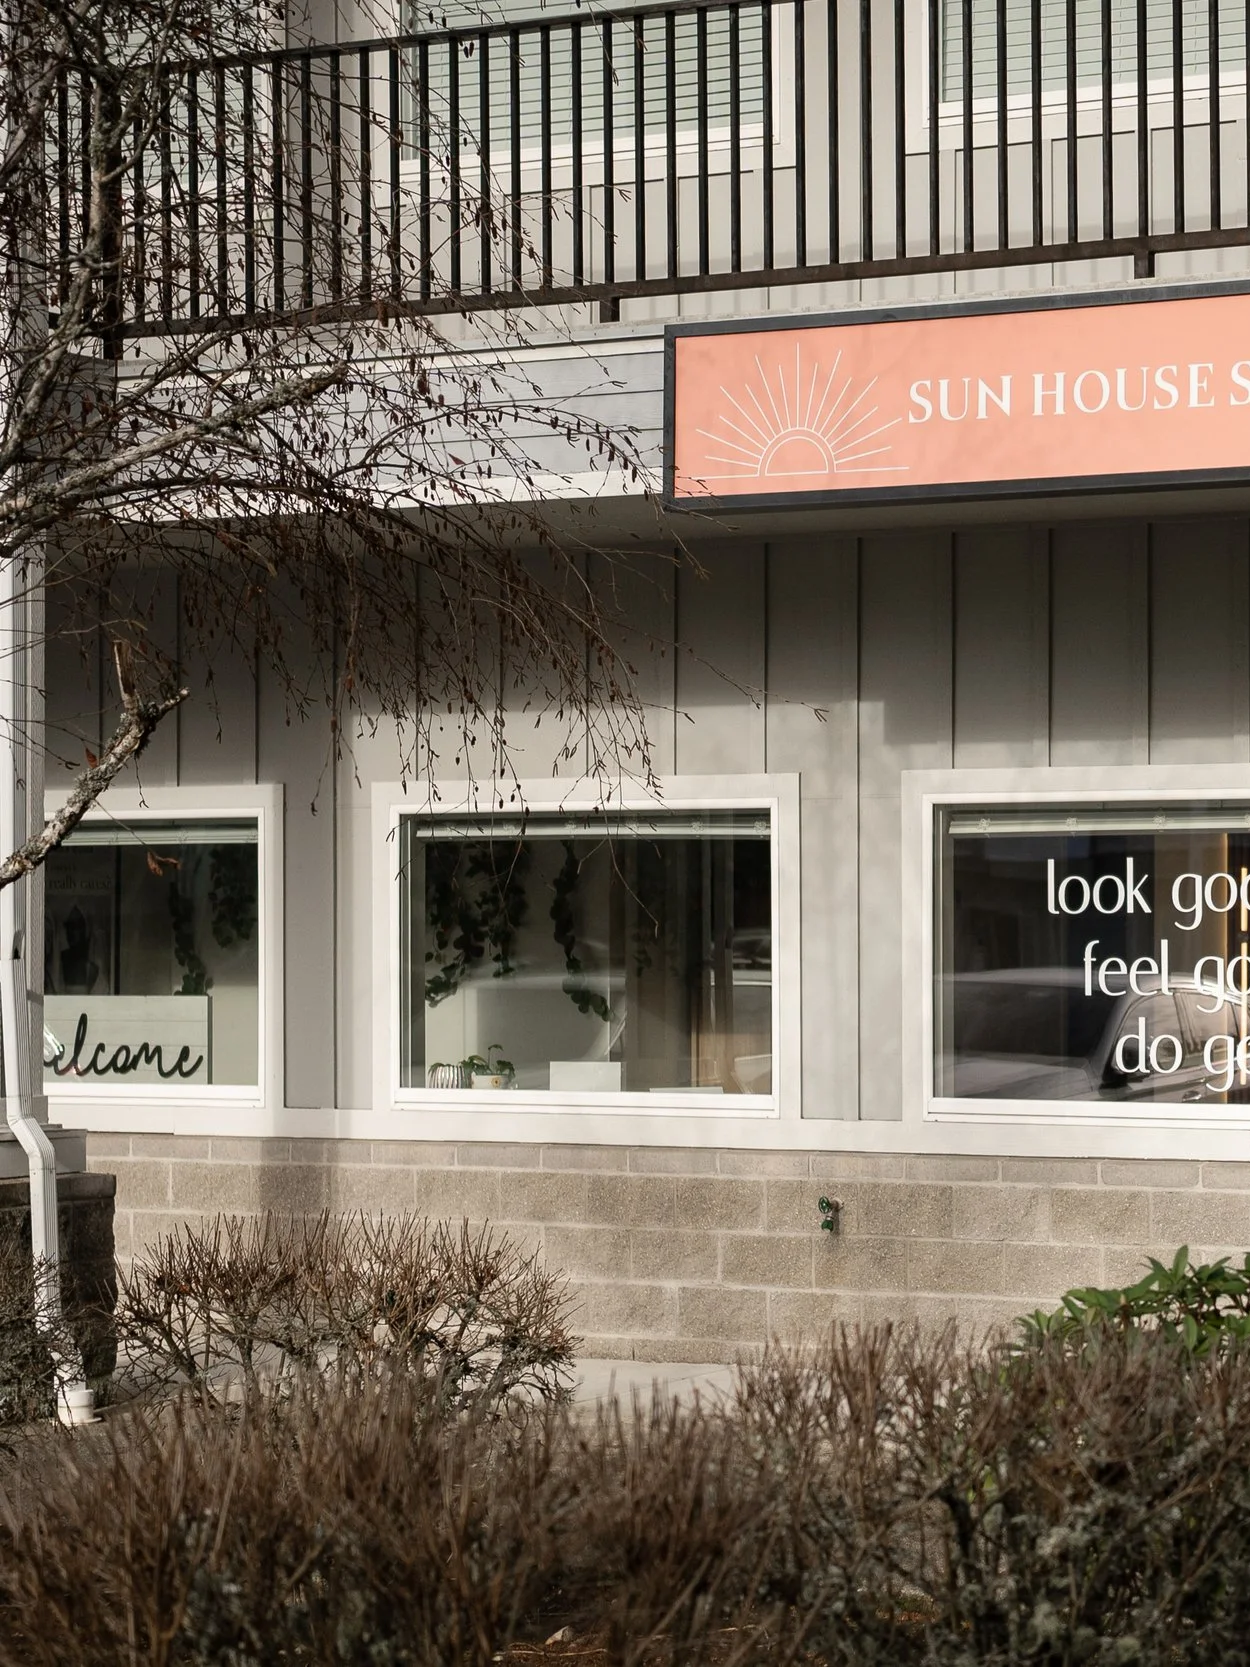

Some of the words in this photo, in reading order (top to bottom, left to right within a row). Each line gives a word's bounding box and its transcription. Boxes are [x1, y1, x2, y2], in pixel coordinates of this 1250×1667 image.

[909, 375, 1013, 423] SUN
[1032, 363, 1214, 416] HOUSE
[1047, 857, 1152, 914] look
[1083, 939, 1173, 996] feel
[1114, 1016, 1183, 1074] do
